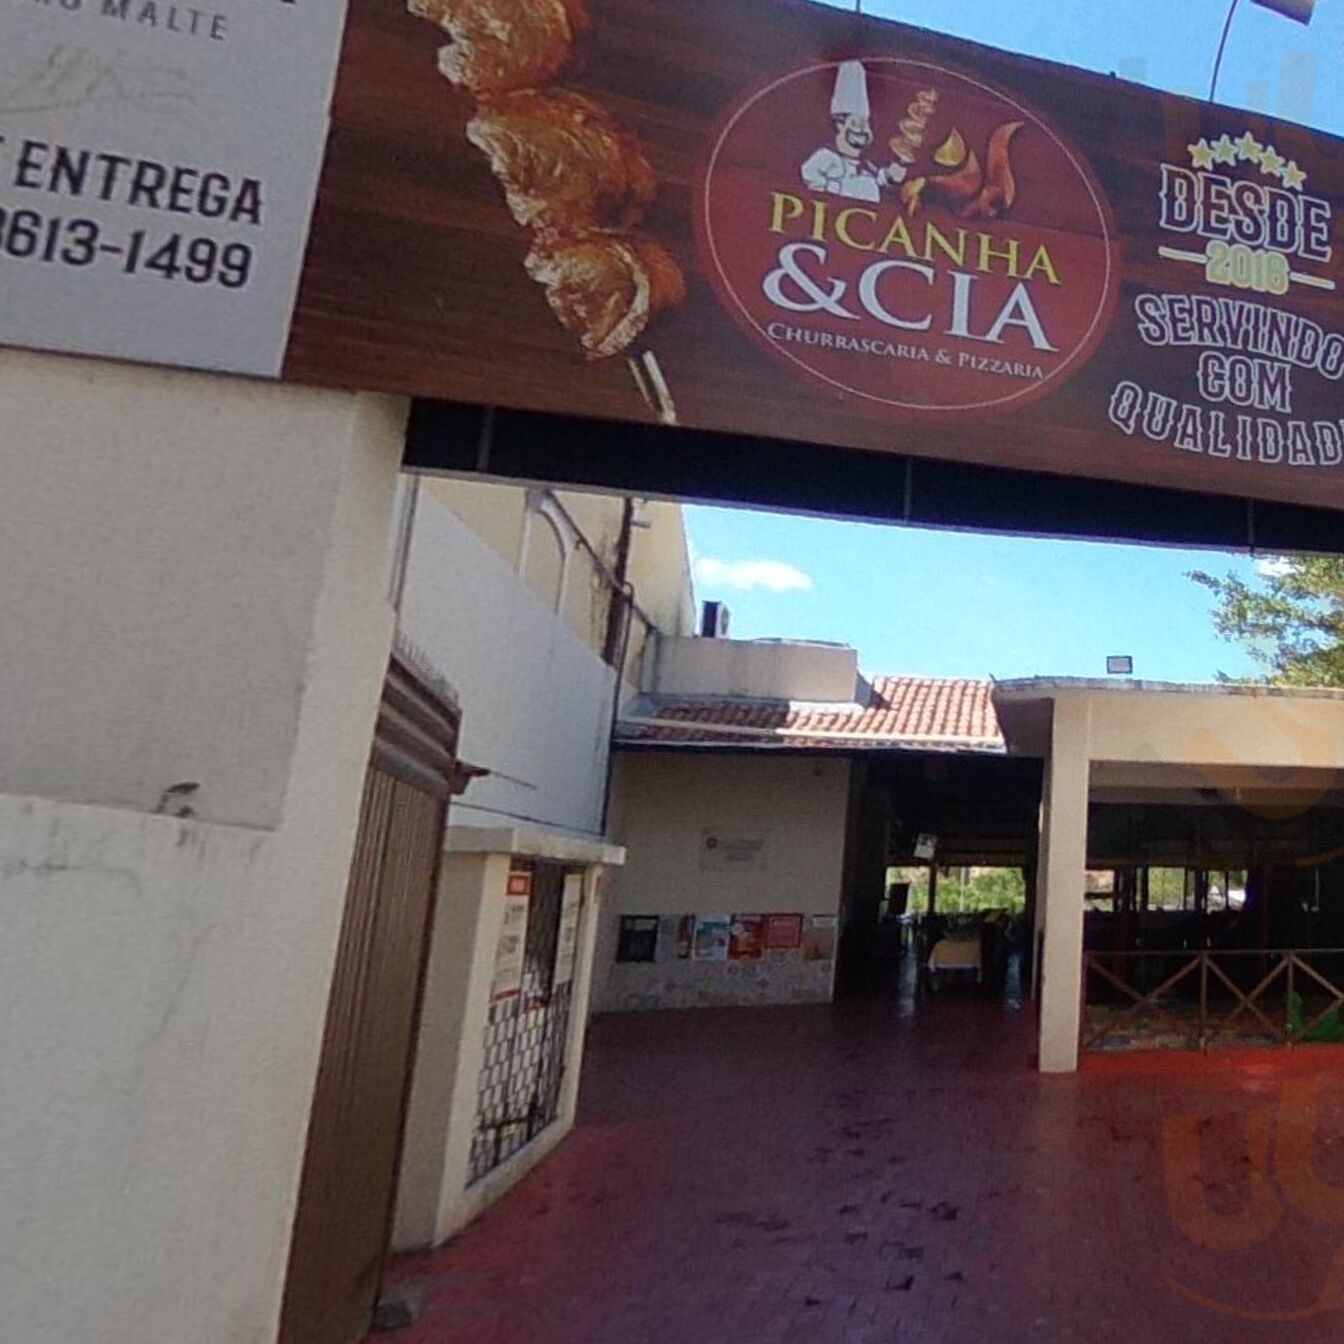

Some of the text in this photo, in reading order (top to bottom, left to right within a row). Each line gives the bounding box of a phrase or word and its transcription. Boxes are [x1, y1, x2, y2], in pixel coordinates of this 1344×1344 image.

[14, 140, 263, 226] ENTREGA
[1158, 163, 1332, 263] DESDE
[0, 207, 253, 288] 613-1499
[769, 191, 1062, 285] PICANHA
[762, 242, 1060, 353] &CIA
[935, 350, 951, 366] &
[1197, 351, 1292, 413] COM
